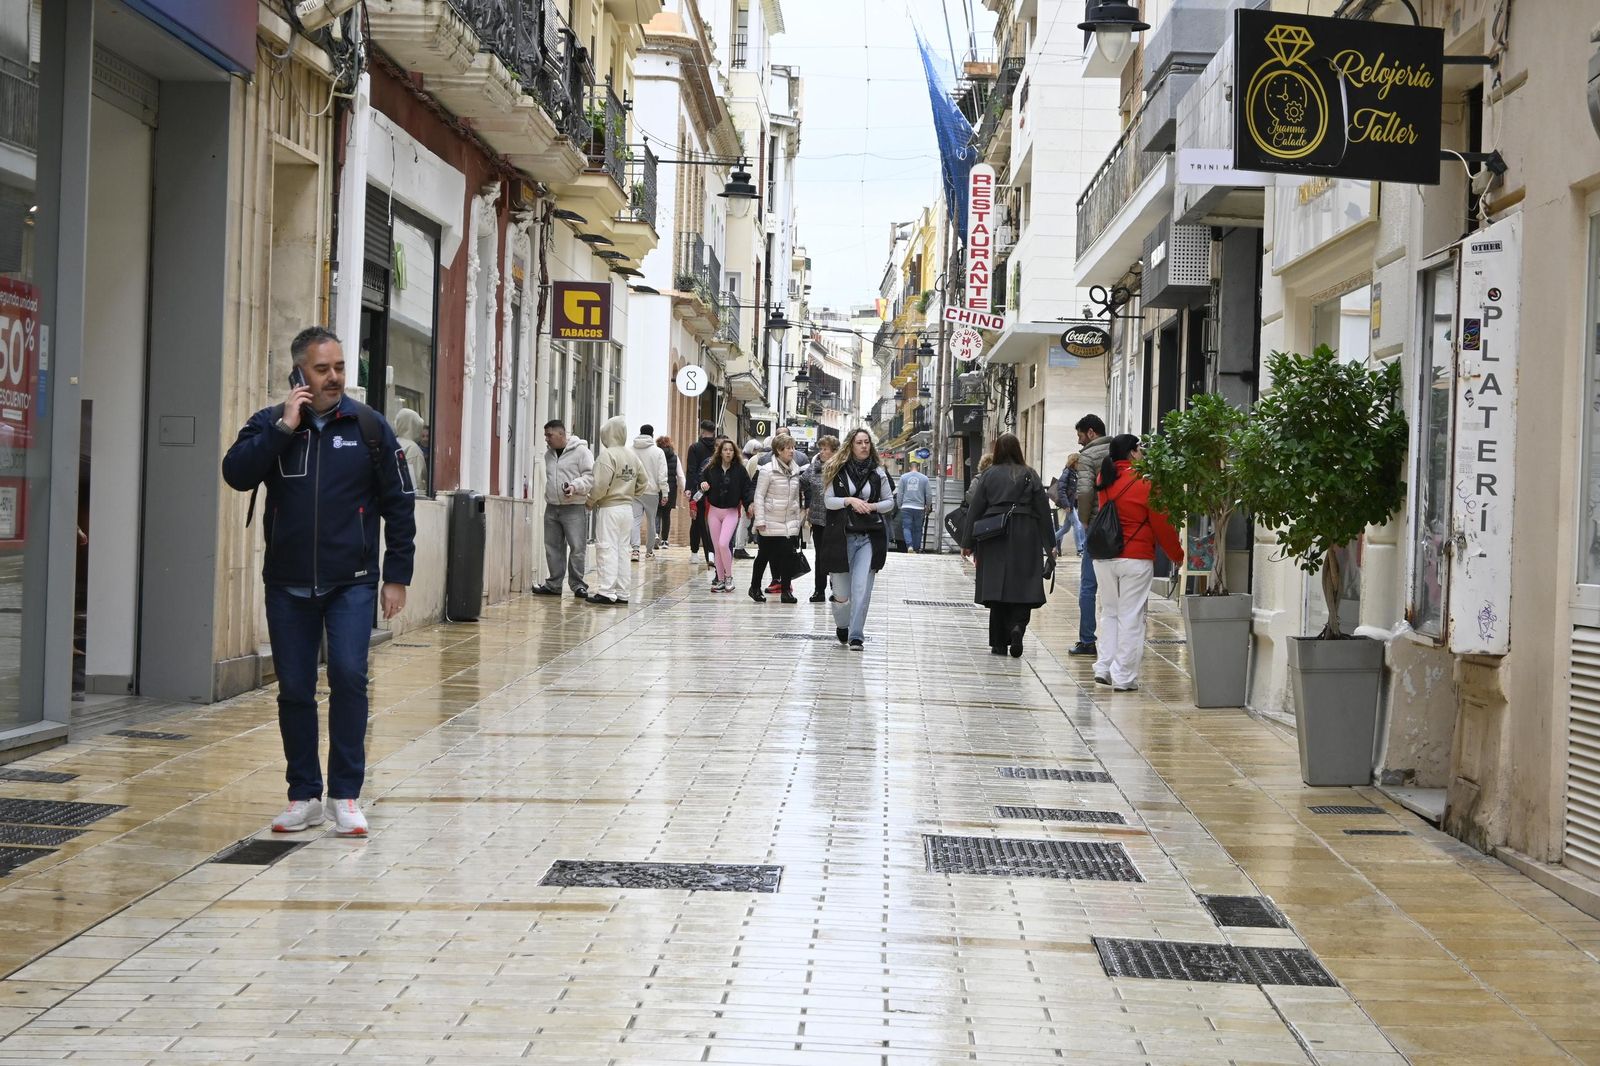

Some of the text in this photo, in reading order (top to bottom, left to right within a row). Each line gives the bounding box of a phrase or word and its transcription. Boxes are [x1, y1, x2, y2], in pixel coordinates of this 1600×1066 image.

[1328, 49, 1435, 100] Relojería
[1267, 119, 1307, 134] Juanma
[1347, 107, 1419, 145] Taller
[969, 174, 992, 309] RESTAURANTE
[1472, 242, 1501, 252] OTHER
[560, 328, 603, 338] TABACOS
[945, 308, 1004, 330] CHINO
[1476, 305, 1503, 558] PLATERÍ
